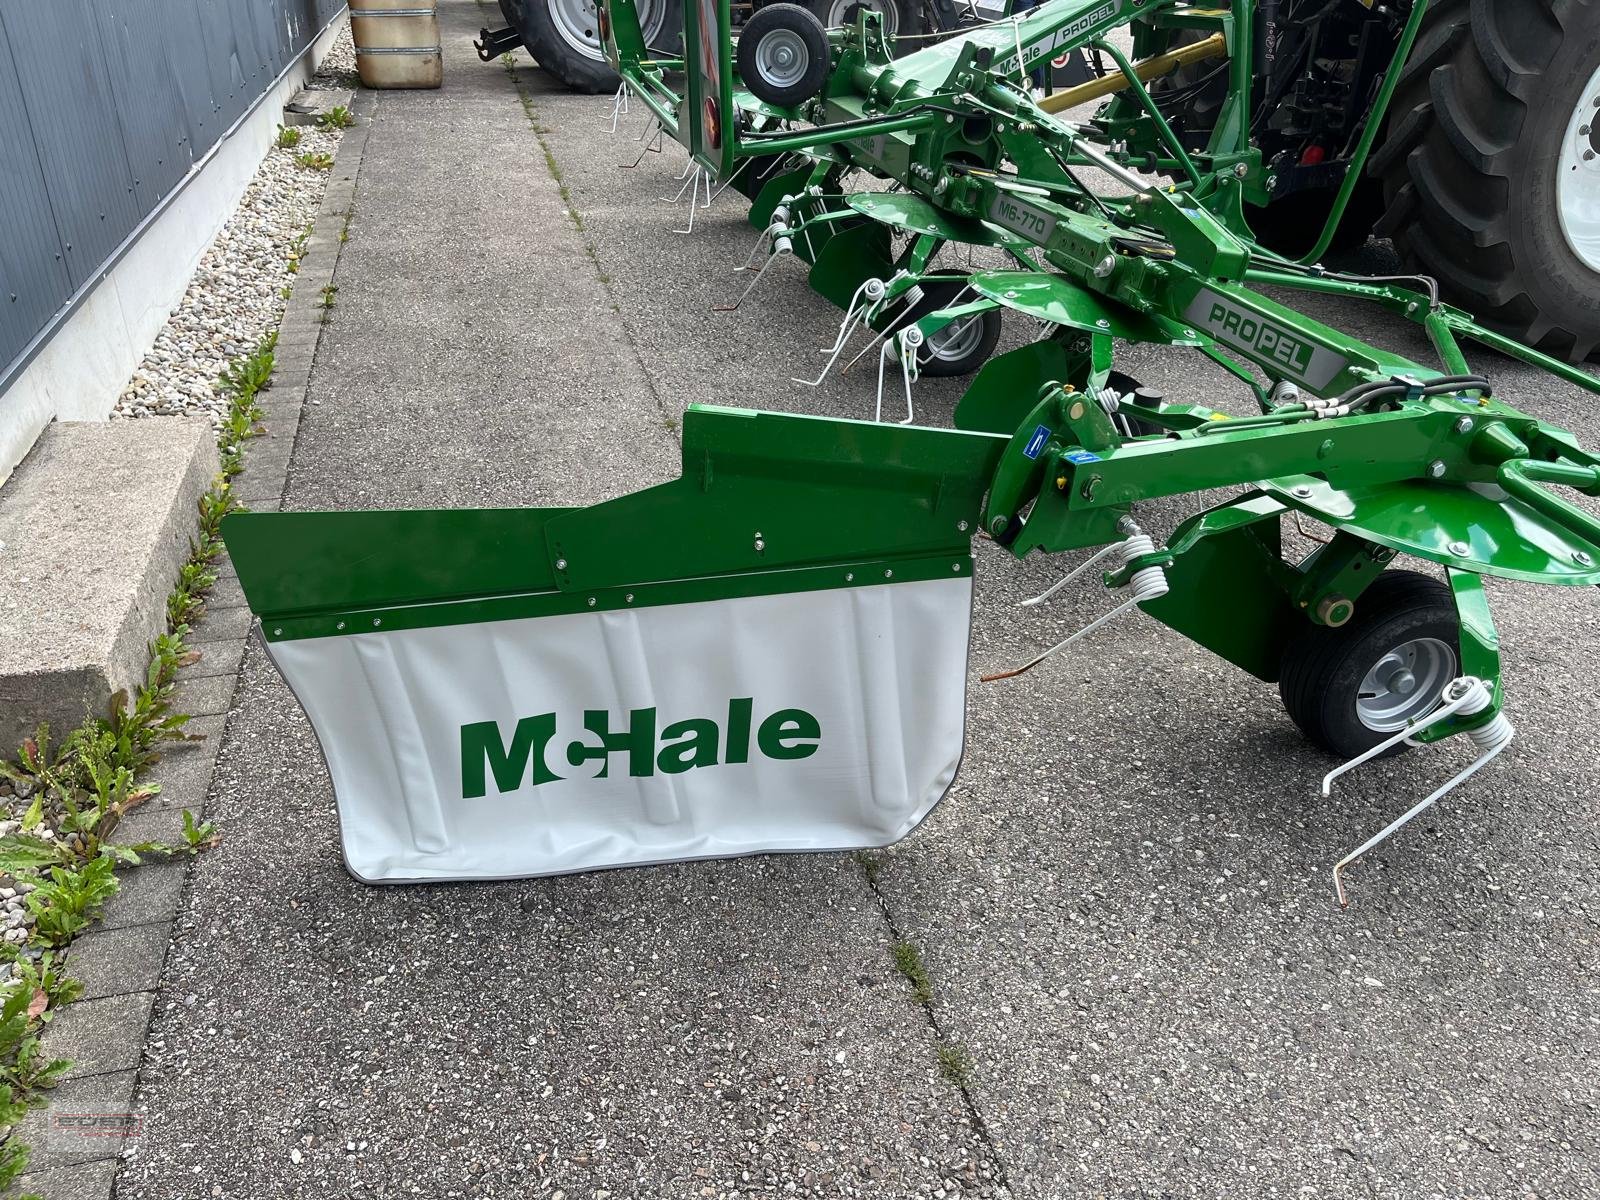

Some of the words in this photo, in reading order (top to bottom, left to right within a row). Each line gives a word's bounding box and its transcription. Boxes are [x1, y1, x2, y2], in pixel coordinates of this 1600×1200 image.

[1062, 6, 1115, 40] PROPEL
[998, 203, 1046, 235] M6-770
[1208, 302, 1306, 371] PROPEL
[460, 697, 821, 799] McHale
